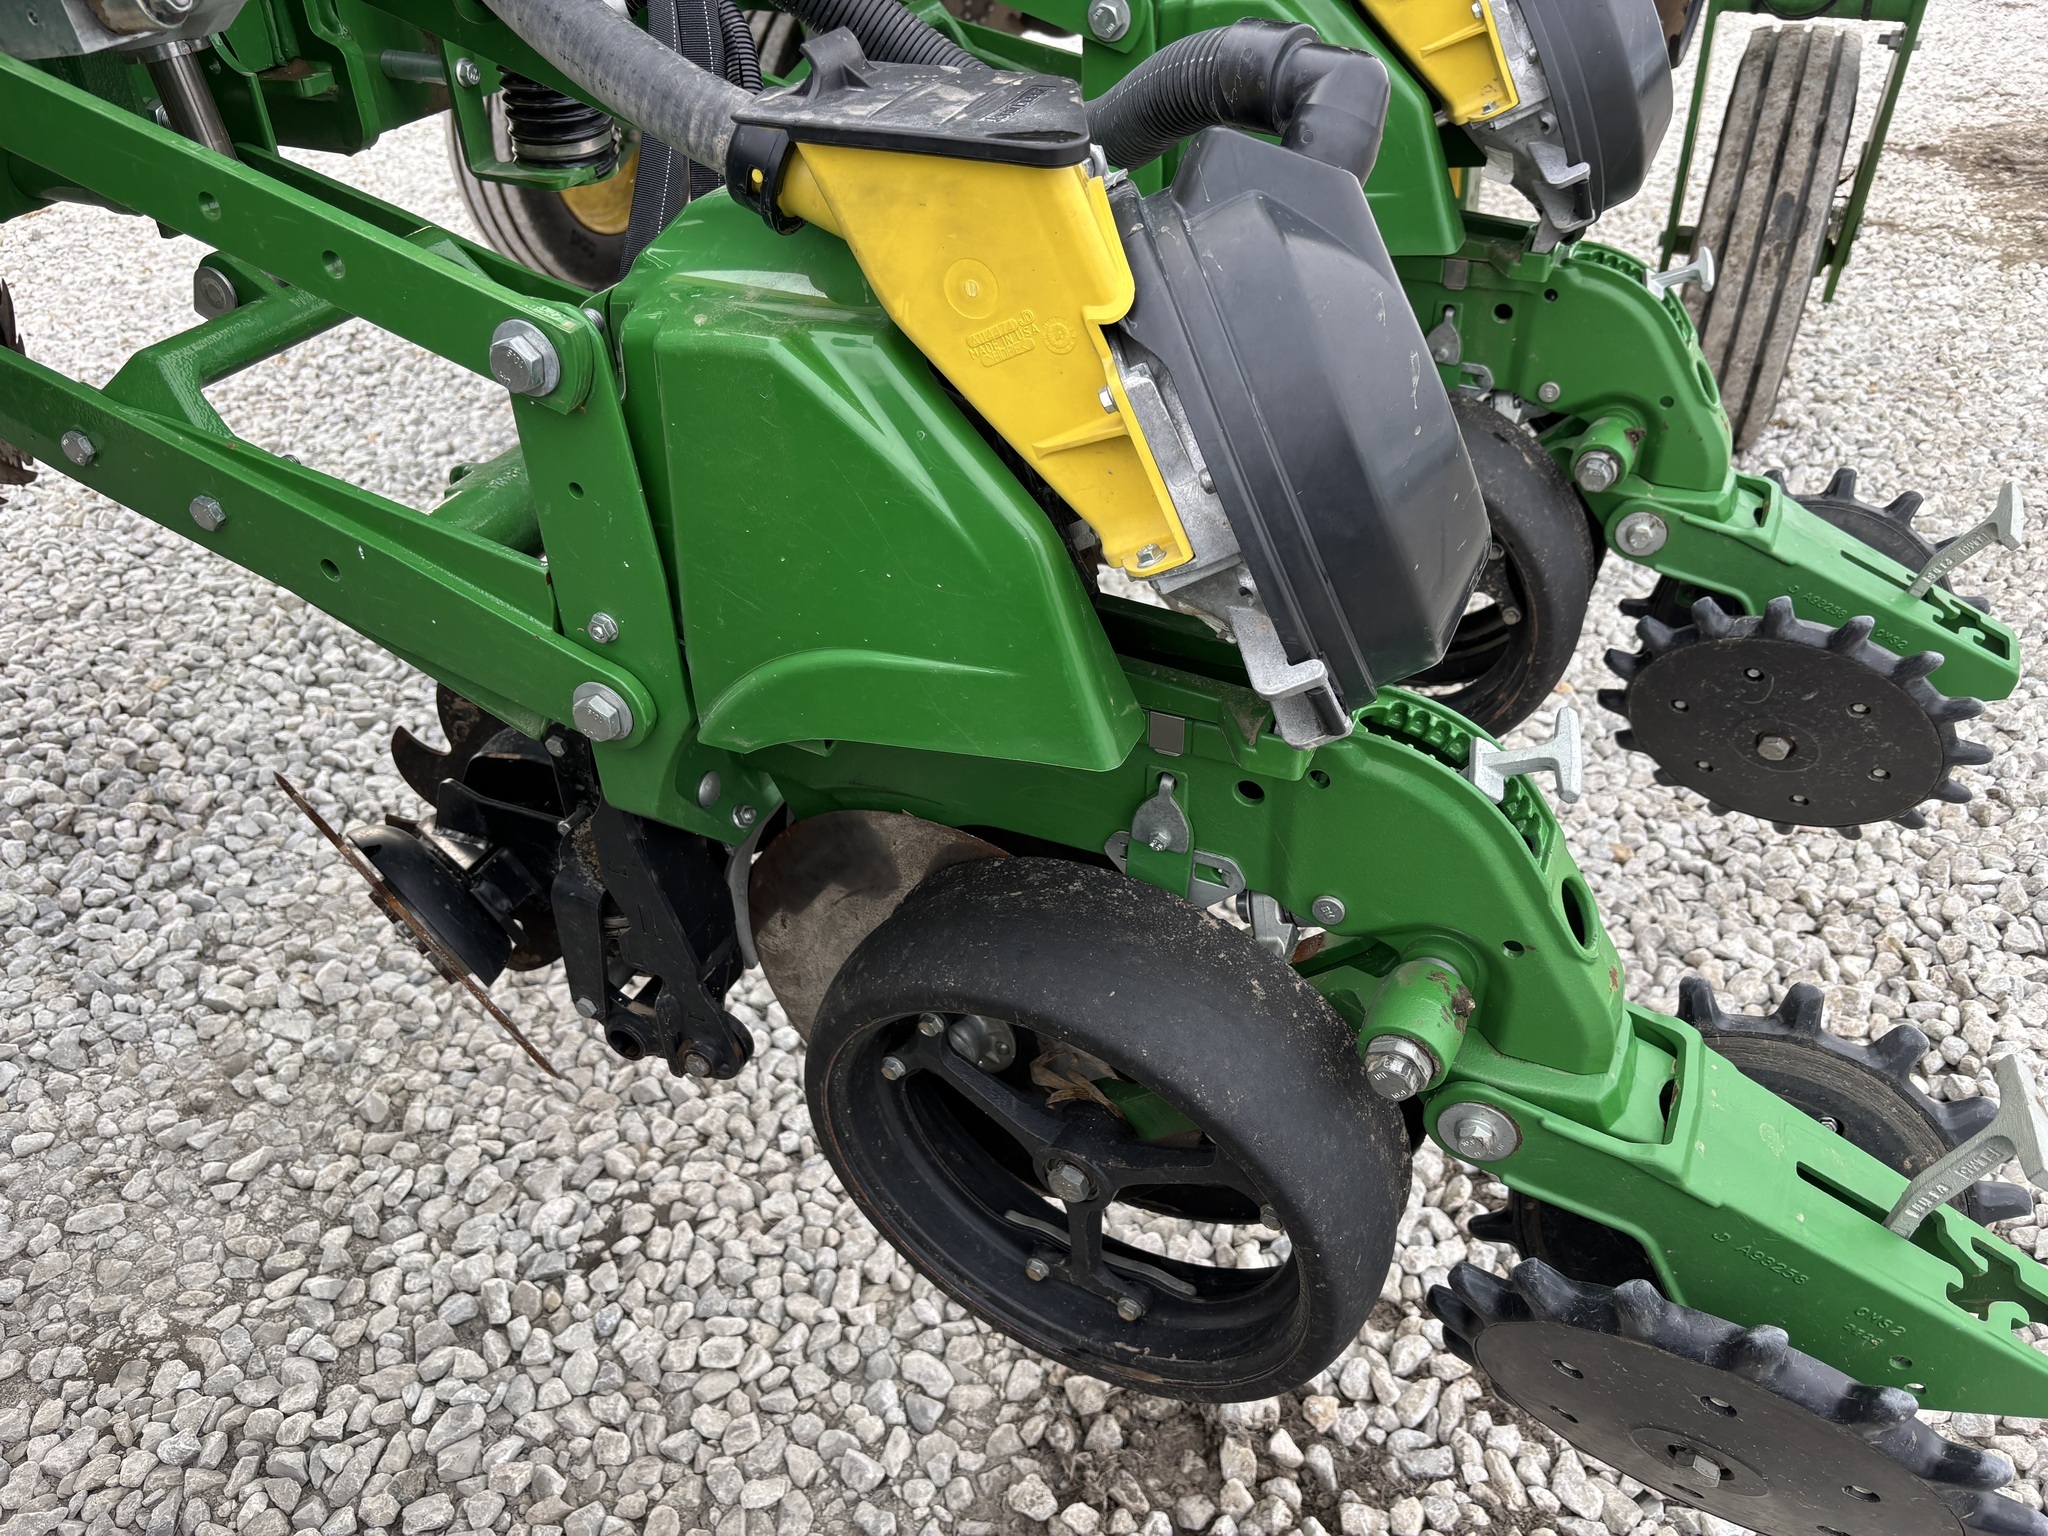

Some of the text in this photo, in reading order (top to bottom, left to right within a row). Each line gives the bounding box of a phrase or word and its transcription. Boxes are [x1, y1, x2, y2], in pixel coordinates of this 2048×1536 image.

[969, 341, 1000, 360] MADE
[1000, 333, 1014, 348] IN
[1015, 323, 1040, 341] USA
